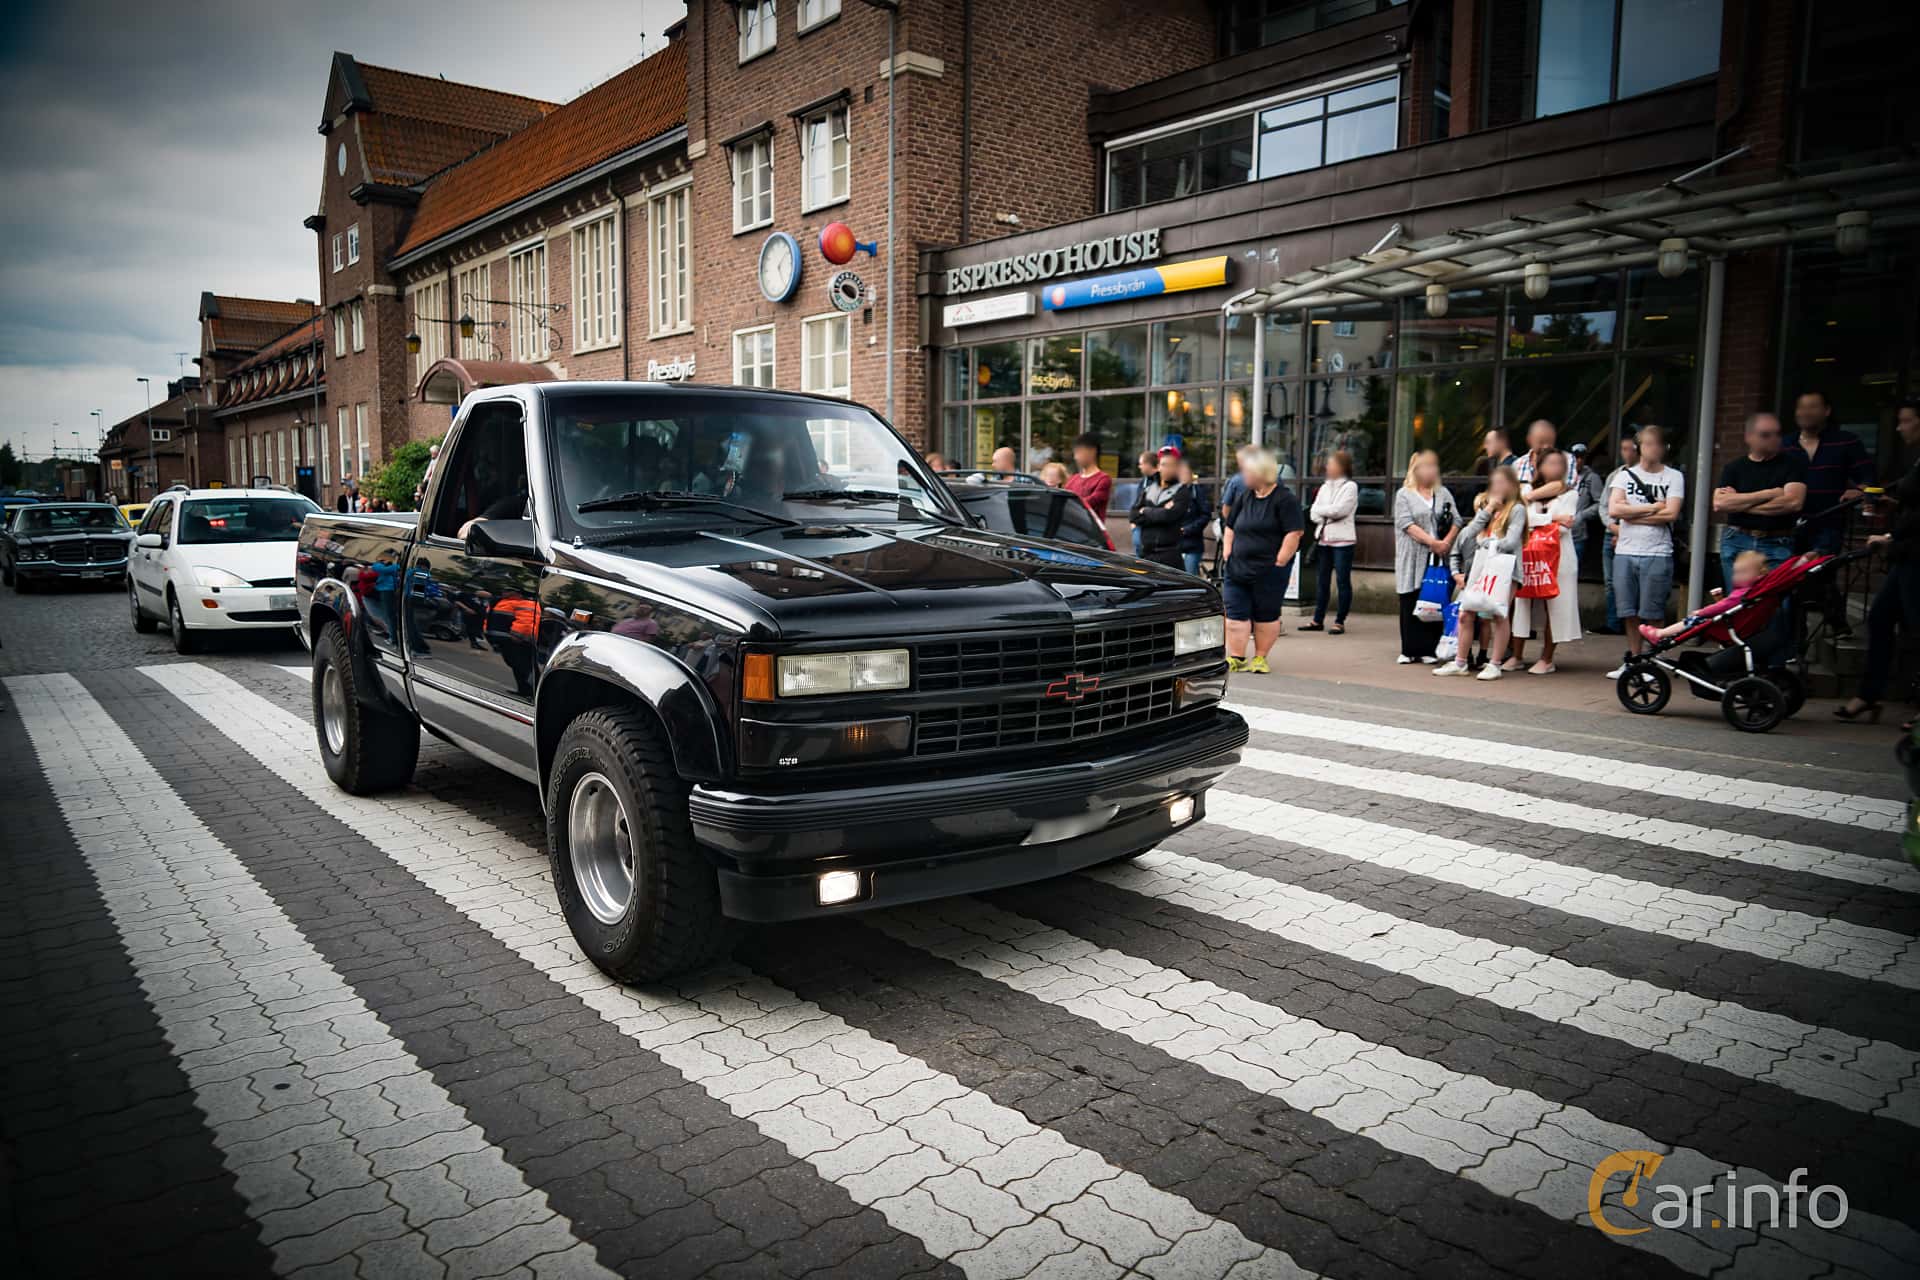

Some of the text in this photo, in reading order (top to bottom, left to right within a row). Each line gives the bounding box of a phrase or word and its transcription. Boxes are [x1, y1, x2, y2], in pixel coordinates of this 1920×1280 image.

[946, 228, 1161, 295] ESPRESSO HOUSE
[1090, 279, 1146, 299] Pressbyrån
